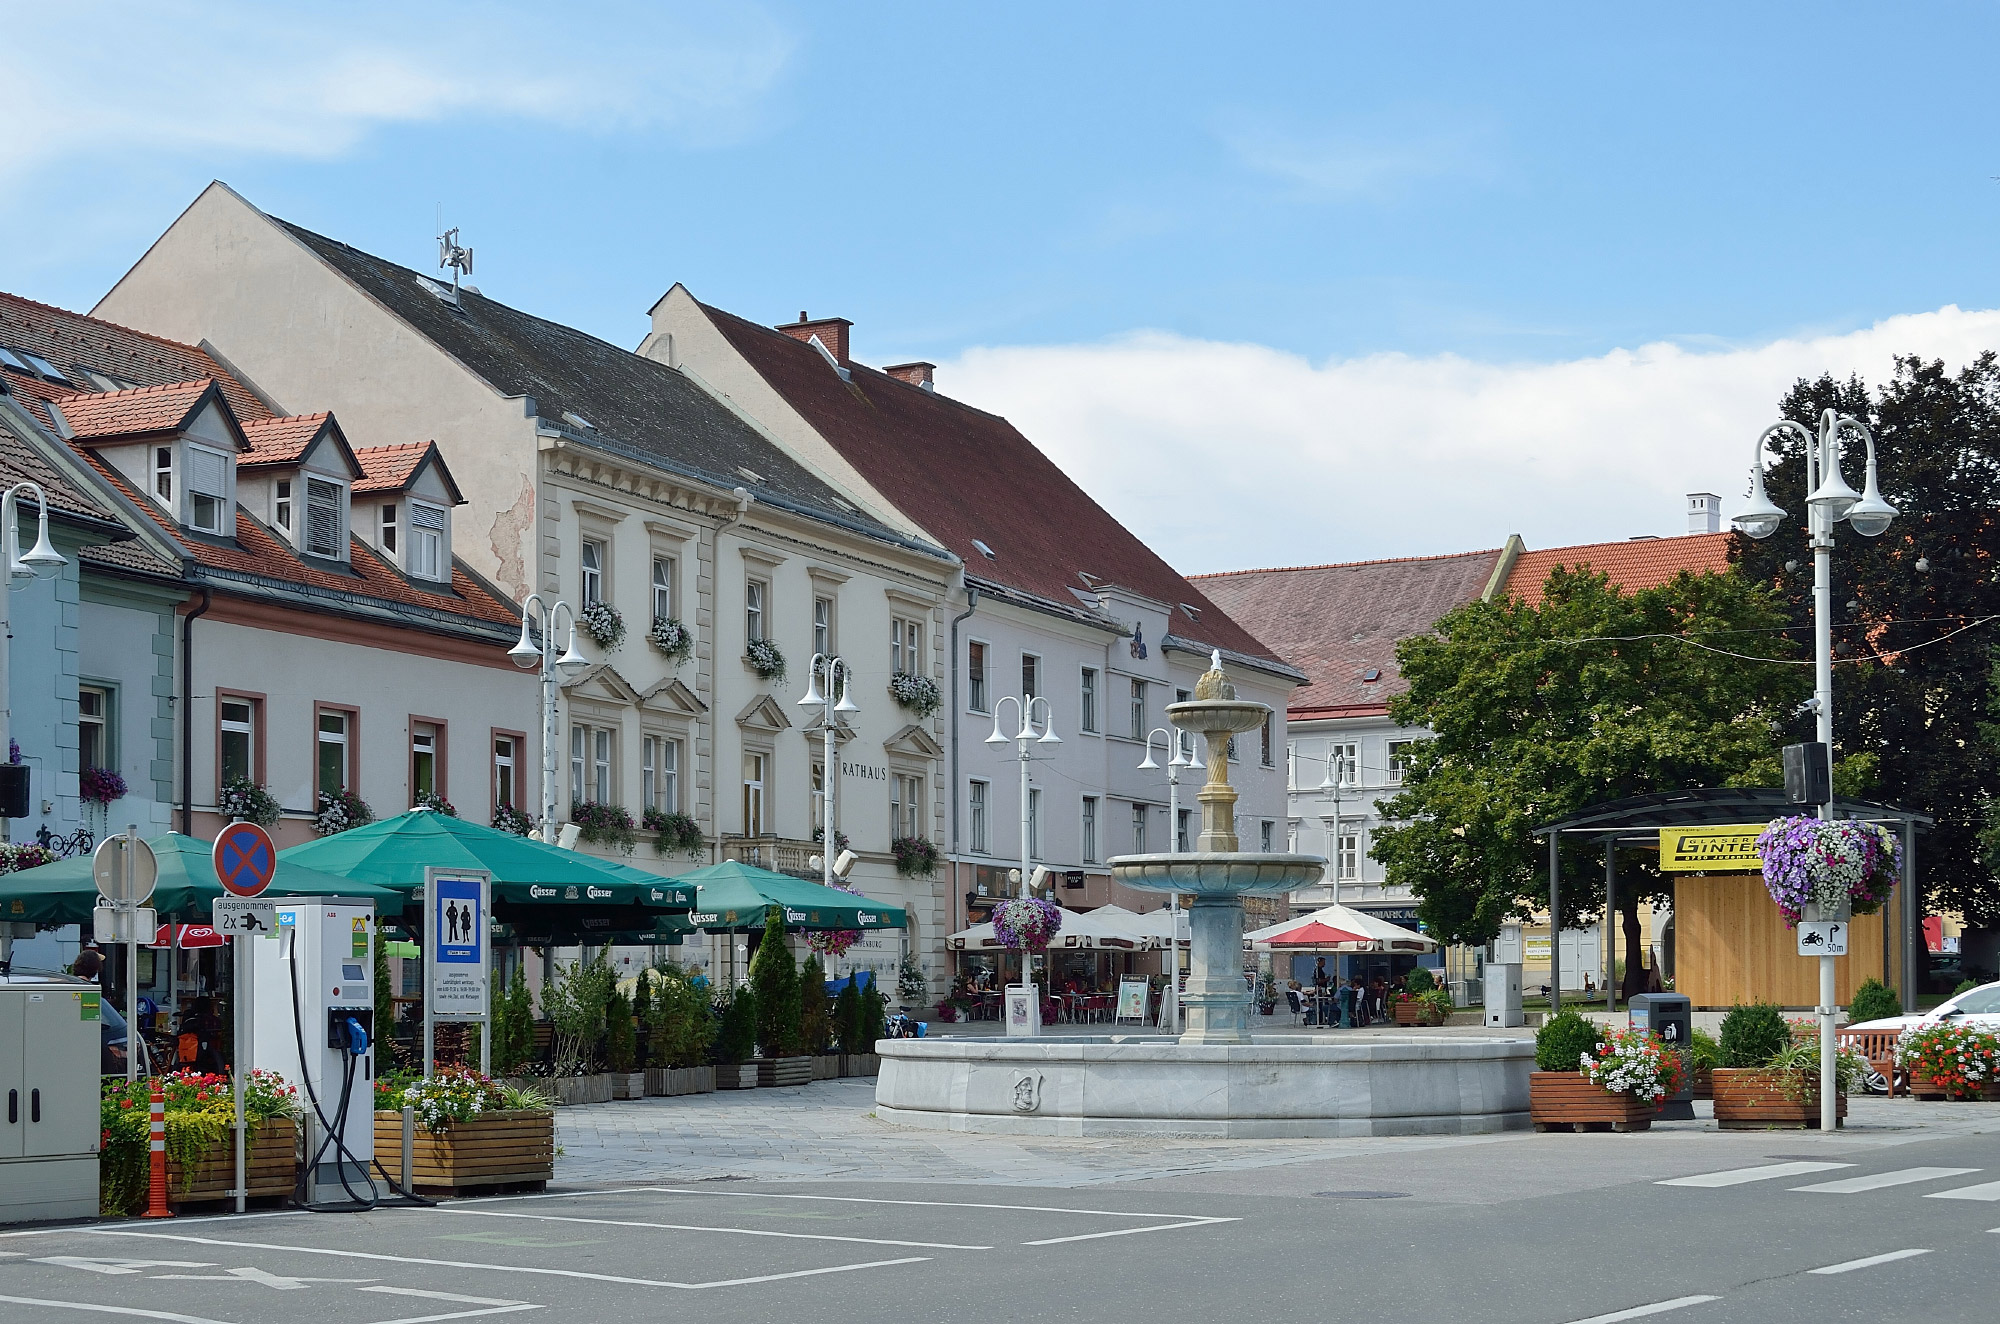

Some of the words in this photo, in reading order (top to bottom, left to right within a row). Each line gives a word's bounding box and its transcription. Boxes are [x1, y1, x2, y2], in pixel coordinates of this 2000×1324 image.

[842, 762, 886, 781] RATHAUS
[529, 884, 557, 899] Gösser
[586, 885, 613, 899] Gösser
[217, 901, 273, 912] ausgenommen
[223, 914, 237, 929] 2x
[687, 908, 718, 926] Gösser
[786, 907, 807, 923] Gösser
[857, 910, 877, 925] Gösser
[1366, 910, 1402, 919] RMARK
[1827, 943, 1844, 953] 50m
